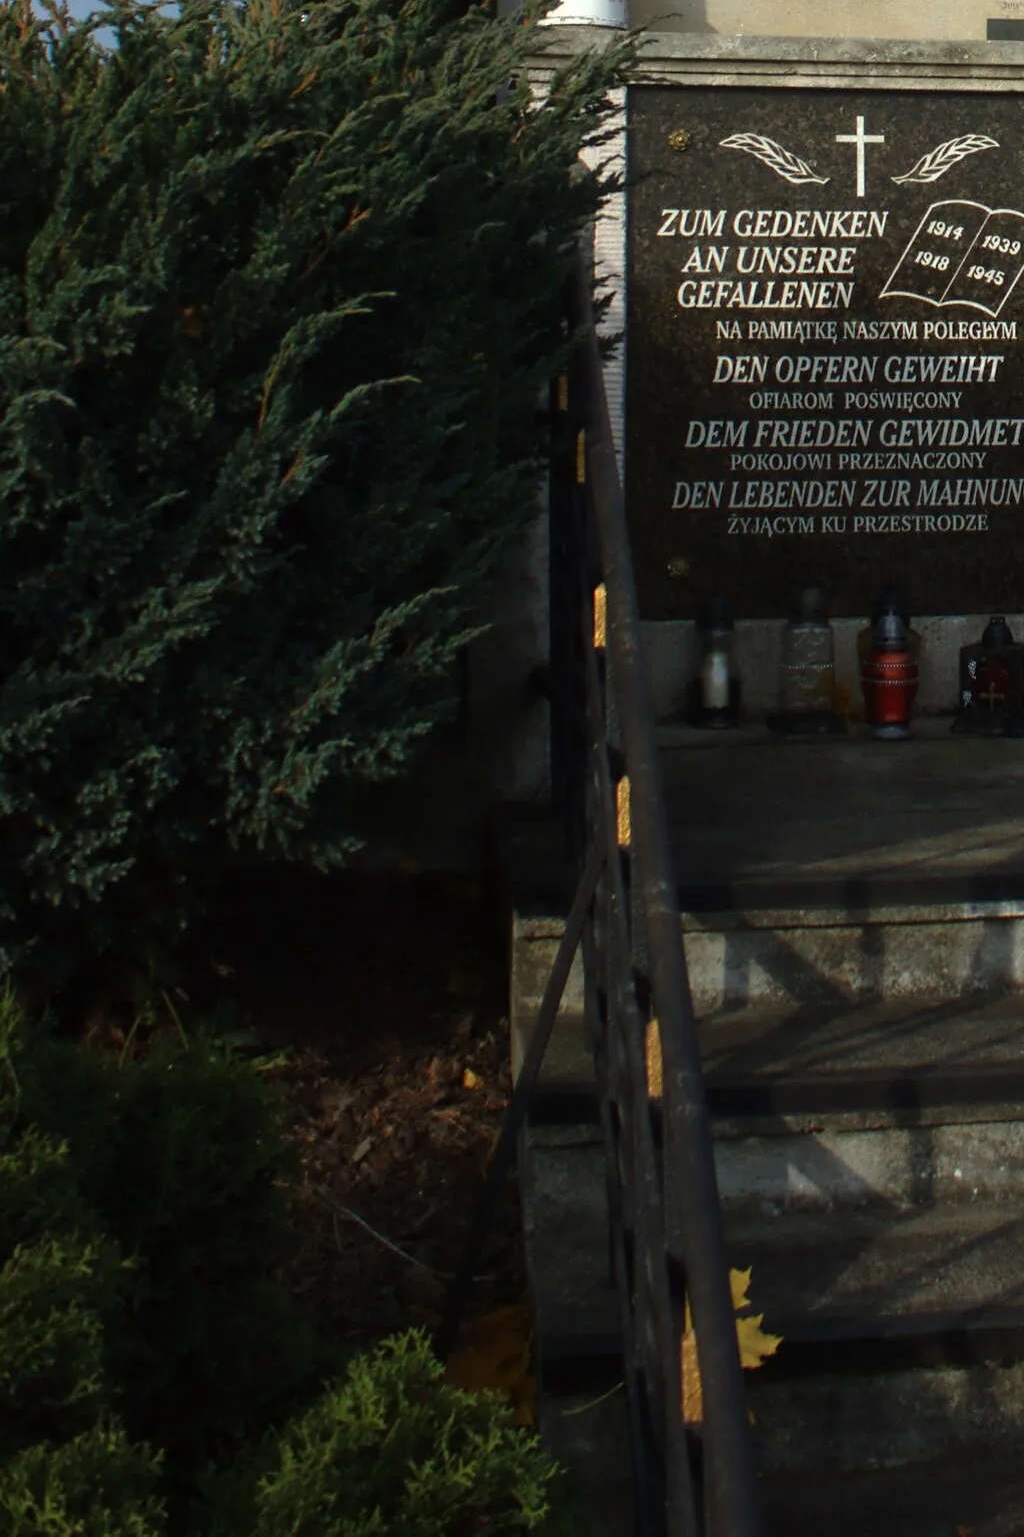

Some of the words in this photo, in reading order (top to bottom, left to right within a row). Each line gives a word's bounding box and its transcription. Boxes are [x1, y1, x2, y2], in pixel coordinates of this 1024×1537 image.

[657, 209, 727, 238] ZUM
[733, 209, 889, 238] GEDENKEN
[926, 220, 965, 242] 1914
[982, 234, 1021, 256] 1939
[682, 246, 729, 274] AN
[737, 246, 856, 275] UNSERE
[914, 250, 951, 272] 1918
[966, 264, 1005, 286] 1945
[677, 281, 854, 310] GEFALLENEN
[716, 321, 742, 339] NA
[748, 321, 838, 344] PAMIĄTKĘ
[843, 321, 918, 340] NASZYM
[923, 321, 1018, 340] POLEGŁYM
[713, 356, 770, 383] DEN
[775, 355, 877, 383] OPFERN
[884, 355, 1004, 383] GEWEIHT
[749, 392, 833, 410] OFIAROM
[844, 387, 963, 413] POŚWIĘCONY
[684, 421, 749, 448] DEM
[753, 420, 874, 448] FRIEDEN
[730, 453, 832, 471] POKOJOWI
[838, 452, 988, 471] PRZEZNACZONY
[672, 481, 724, 509] DEN
[728, 480, 857, 509] LEBENDEN
[860, 480, 911, 507] ZUR
[728, 512, 815, 538] ŻYJĄCYM
[821, 516, 847, 534] KU
[853, 514, 989, 534] PRZESTRODZE
